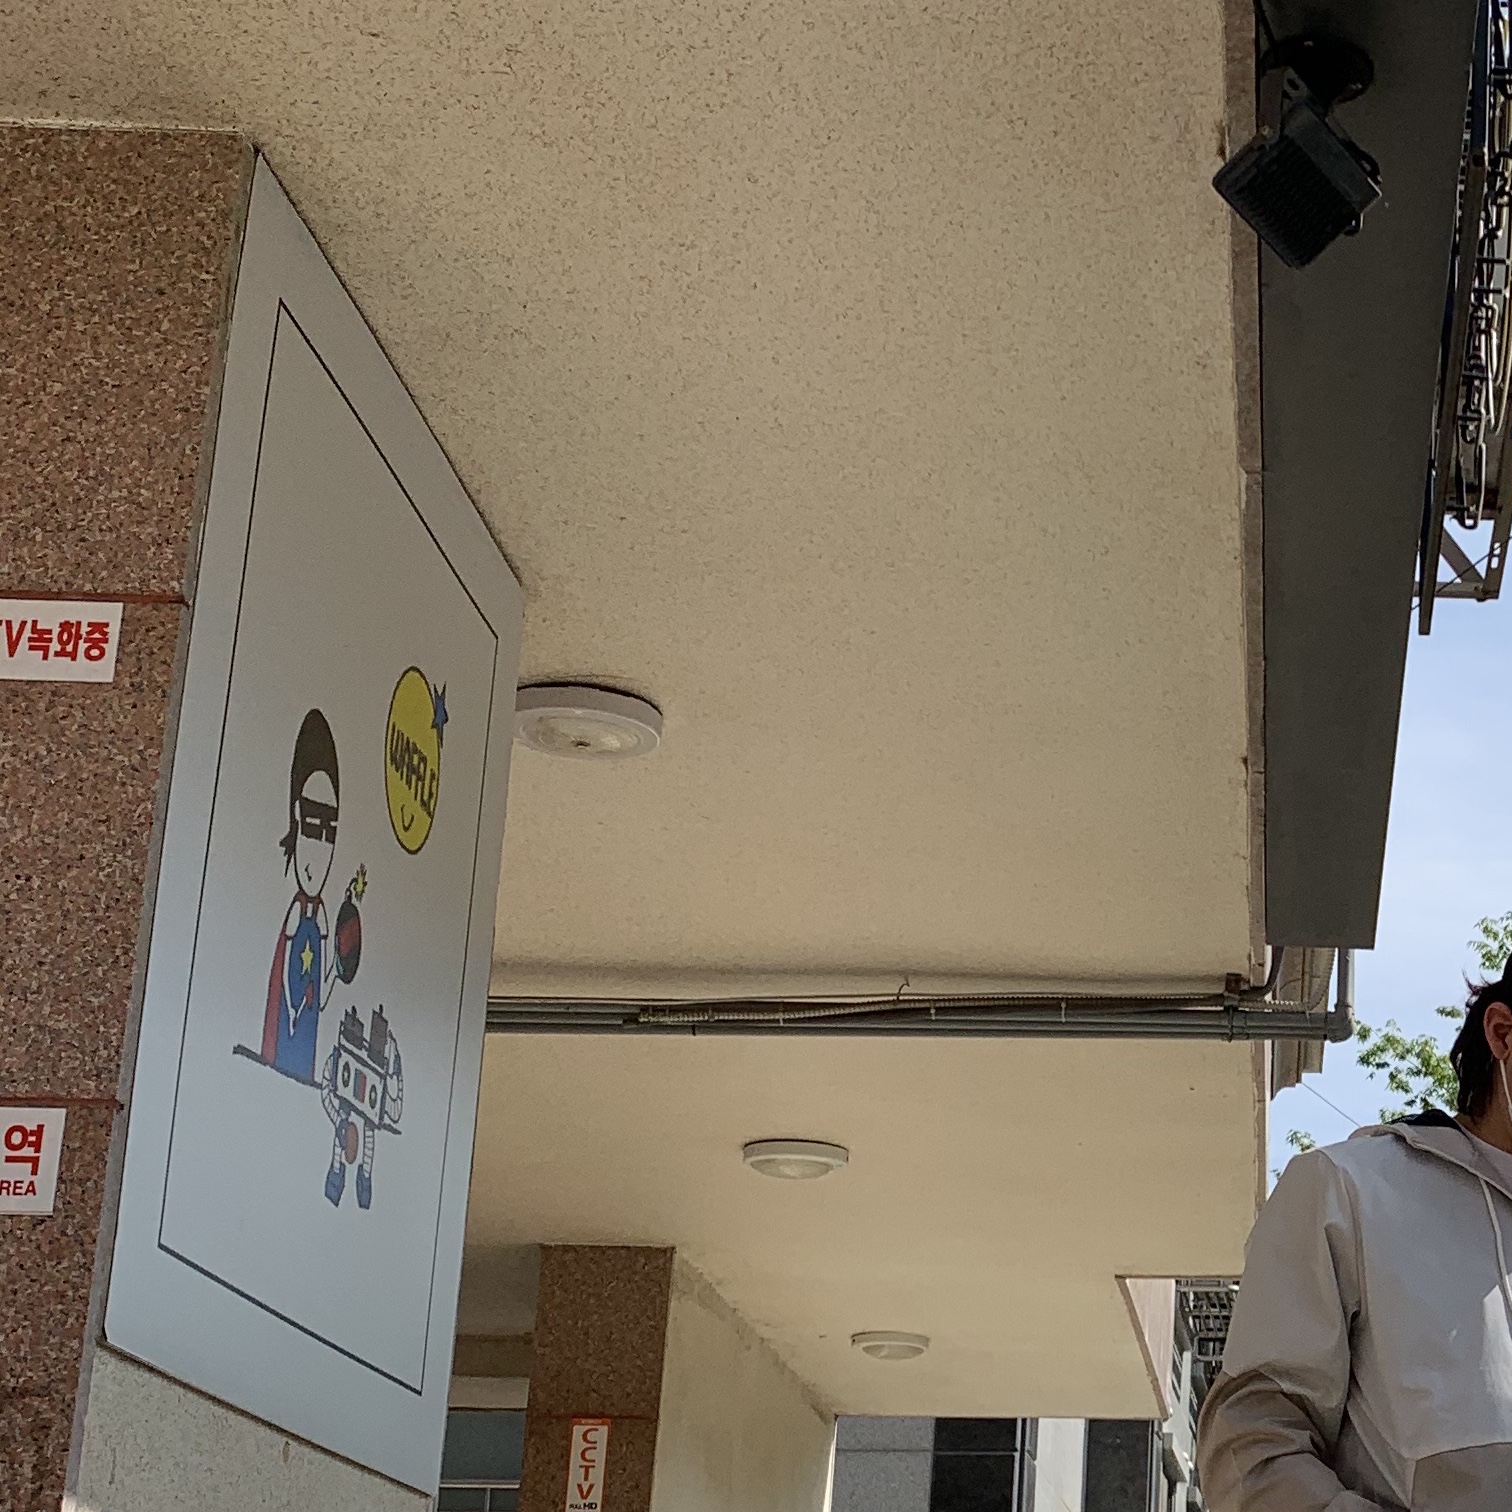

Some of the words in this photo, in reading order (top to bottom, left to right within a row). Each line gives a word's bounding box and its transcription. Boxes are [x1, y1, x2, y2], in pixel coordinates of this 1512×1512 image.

[0, 619, 110, 662] V녹화중
[4, 1123, 46, 1177] 역
[576, 1427, 600, 1501] CCTV
[583, 1501, 598, 1511] HD
